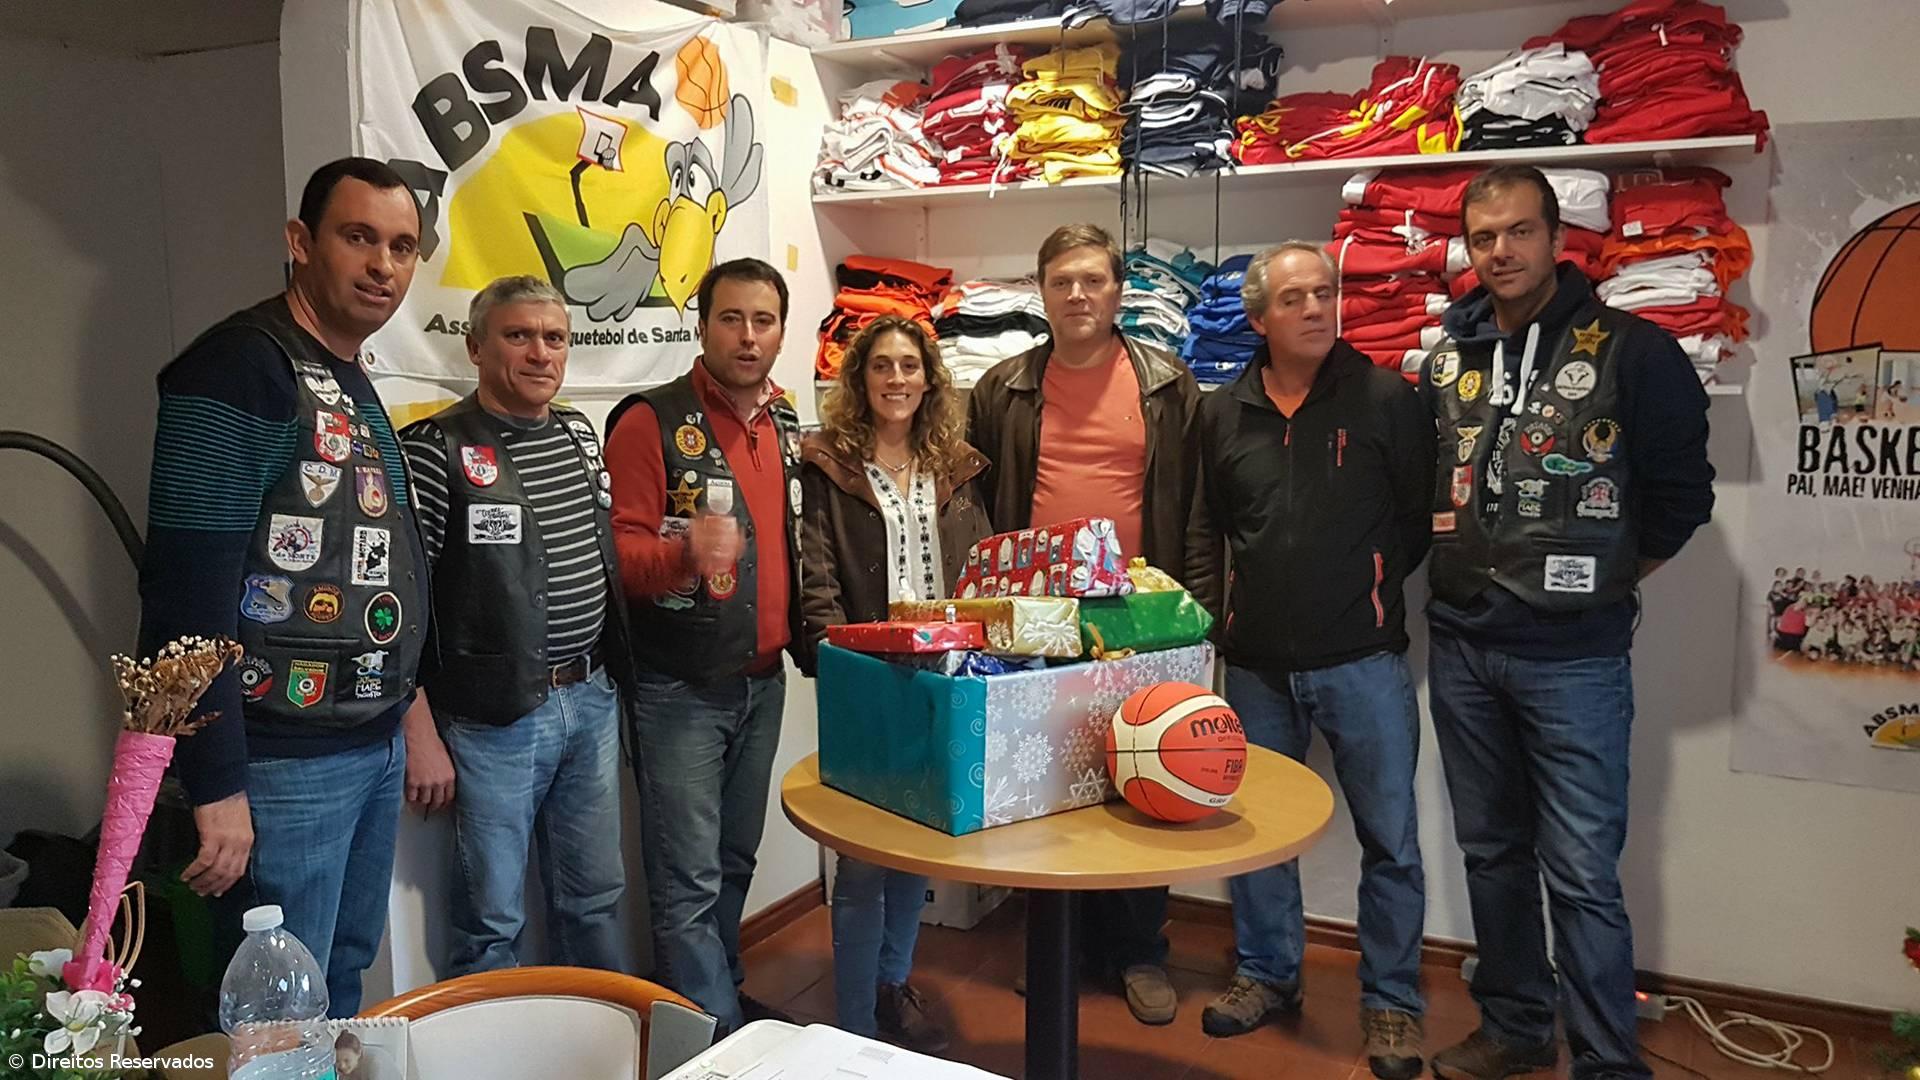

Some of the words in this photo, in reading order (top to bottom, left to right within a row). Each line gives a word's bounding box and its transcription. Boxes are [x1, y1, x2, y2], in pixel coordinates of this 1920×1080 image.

[627, 328, 648, 344] de
[651, 327, 691, 343] Santa
[1797, 425, 1920, 476] BASKE
[1787, 473, 1816, 498] PAI,
